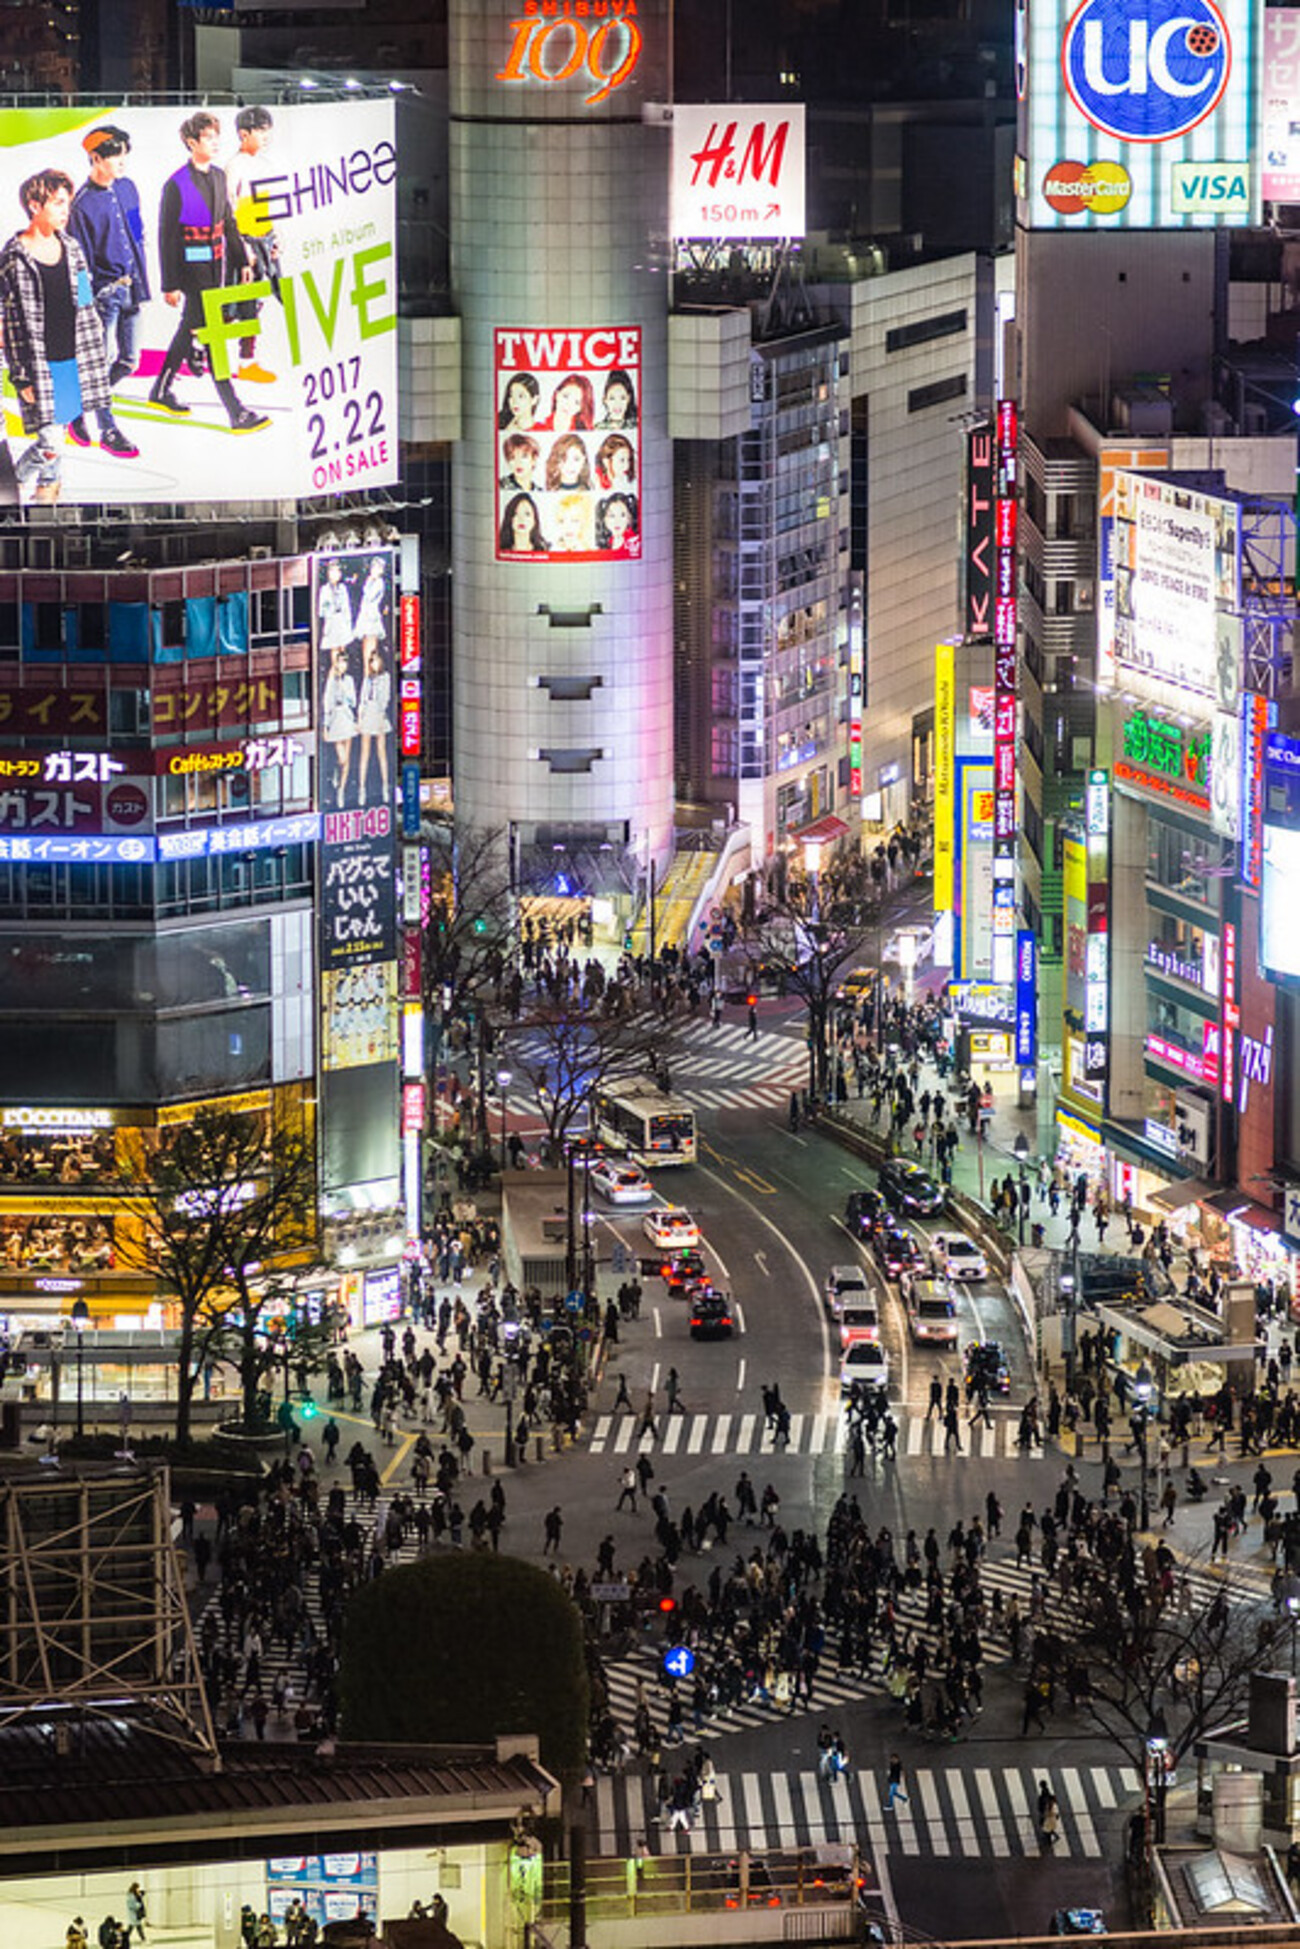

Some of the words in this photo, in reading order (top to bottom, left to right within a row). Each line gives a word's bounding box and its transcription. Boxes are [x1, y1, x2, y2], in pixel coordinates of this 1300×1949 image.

[524, 0, 639, 16] SHIBUYA
[495, 17, 643, 104] 109
[690, 121, 790, 188] H&M
[1045, 179, 1130, 197] MasterCard
[1182, 176, 1247, 200] VISA
[302, 240, 326, 259] 5th
[331, 221, 376, 248] Album
[197, 241, 397, 381] FIVE
[498, 331, 640, 367] TWICE
[303, 356, 360, 407] 2017
[307, 390, 386, 460] 2.22
[312, 459, 342, 489] ON
[346, 440, 388, 476] SALE
[154, 681, 277, 722] コンタクト
[44, 751, 126, 782] ガスト
[246, 738, 304, 770] ガスト
[0, 789, 92, 828] ガスト
[324, 807, 391, 844] HKT48
[325, 855, 392, 887] バグって
[337, 883, 379, 911] いい
[334, 908, 383, 941] じゃん
